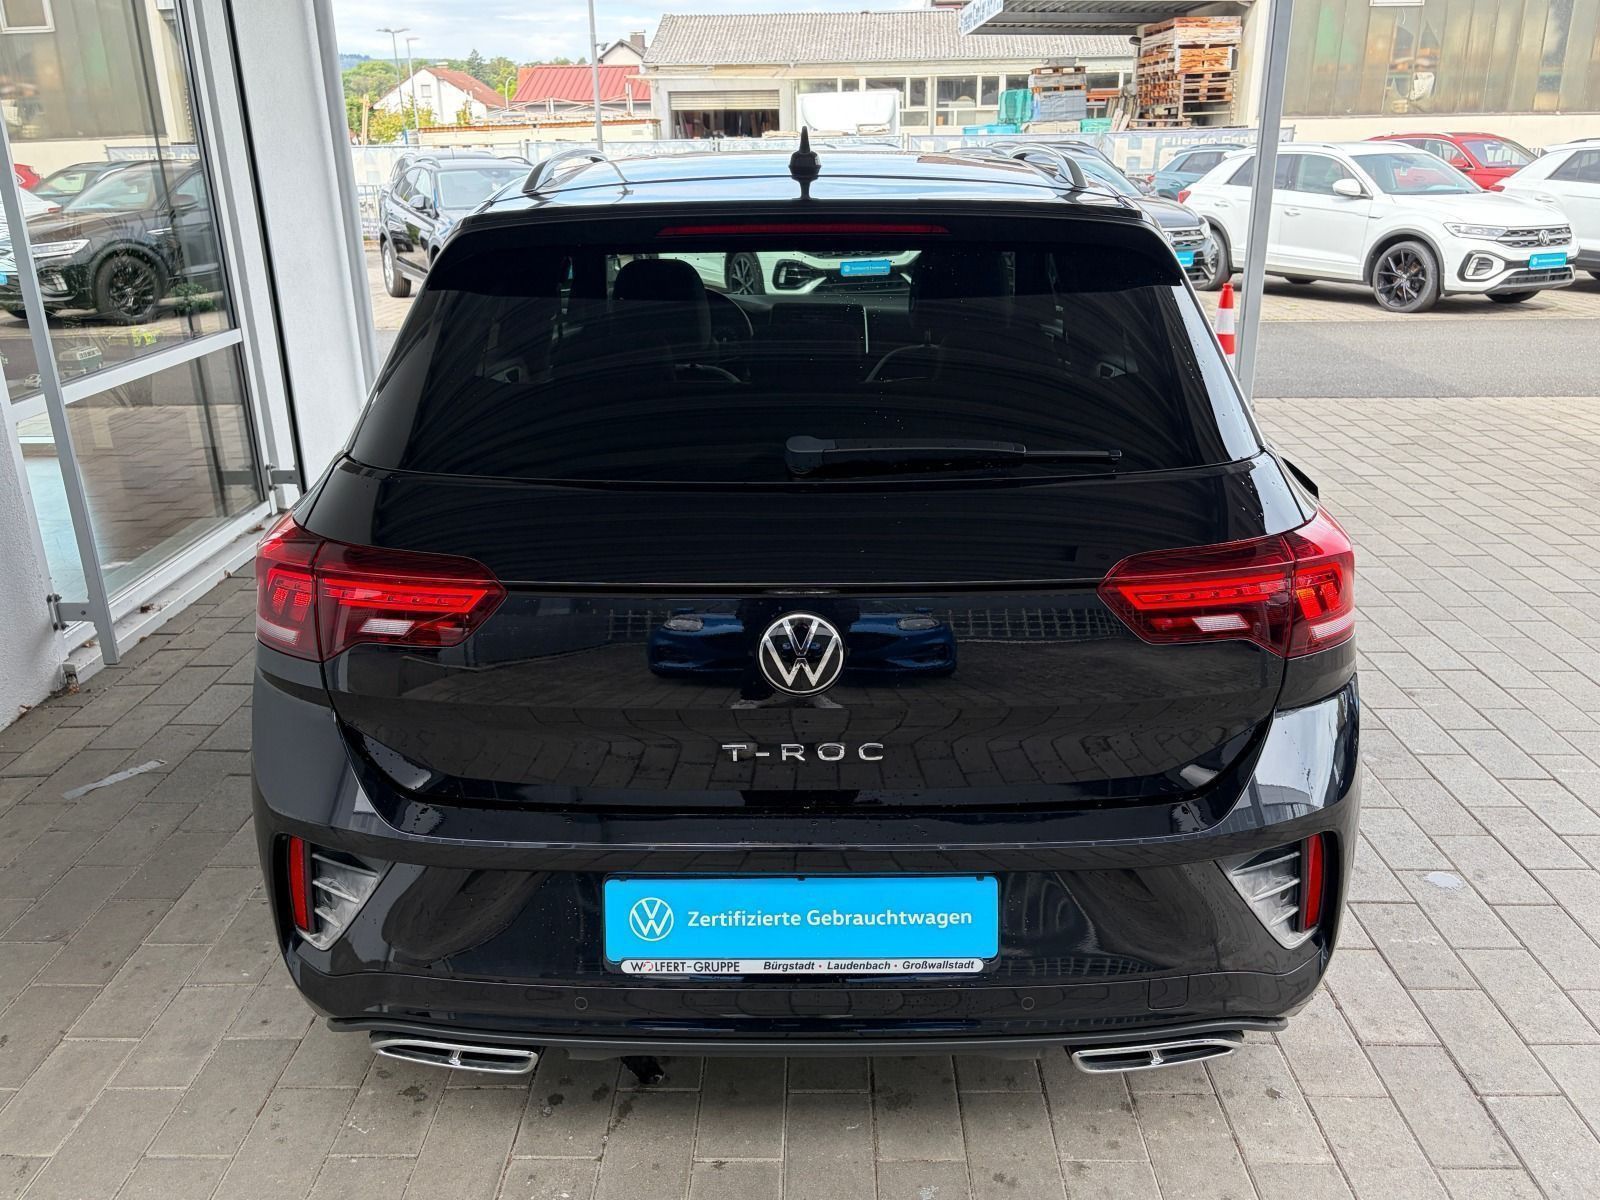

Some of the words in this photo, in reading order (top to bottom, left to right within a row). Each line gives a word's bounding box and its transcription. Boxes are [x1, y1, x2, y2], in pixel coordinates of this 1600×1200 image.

[763, 616, 840, 690] VW
[721, 742, 884, 762] T-ROC
[630, 898, 673, 939] VW
[687, 910, 801, 927] Zertifizierte
[806, 909, 972, 928] Gebrauchtwagen
[631, 961, 740, 973] WOLFERT-GRUPPE
[763, 960, 815, 972] Bürgstadt
[827, 960, 891, 970] Laudenbach
[902, 959, 975, 970] Großwallstadt
